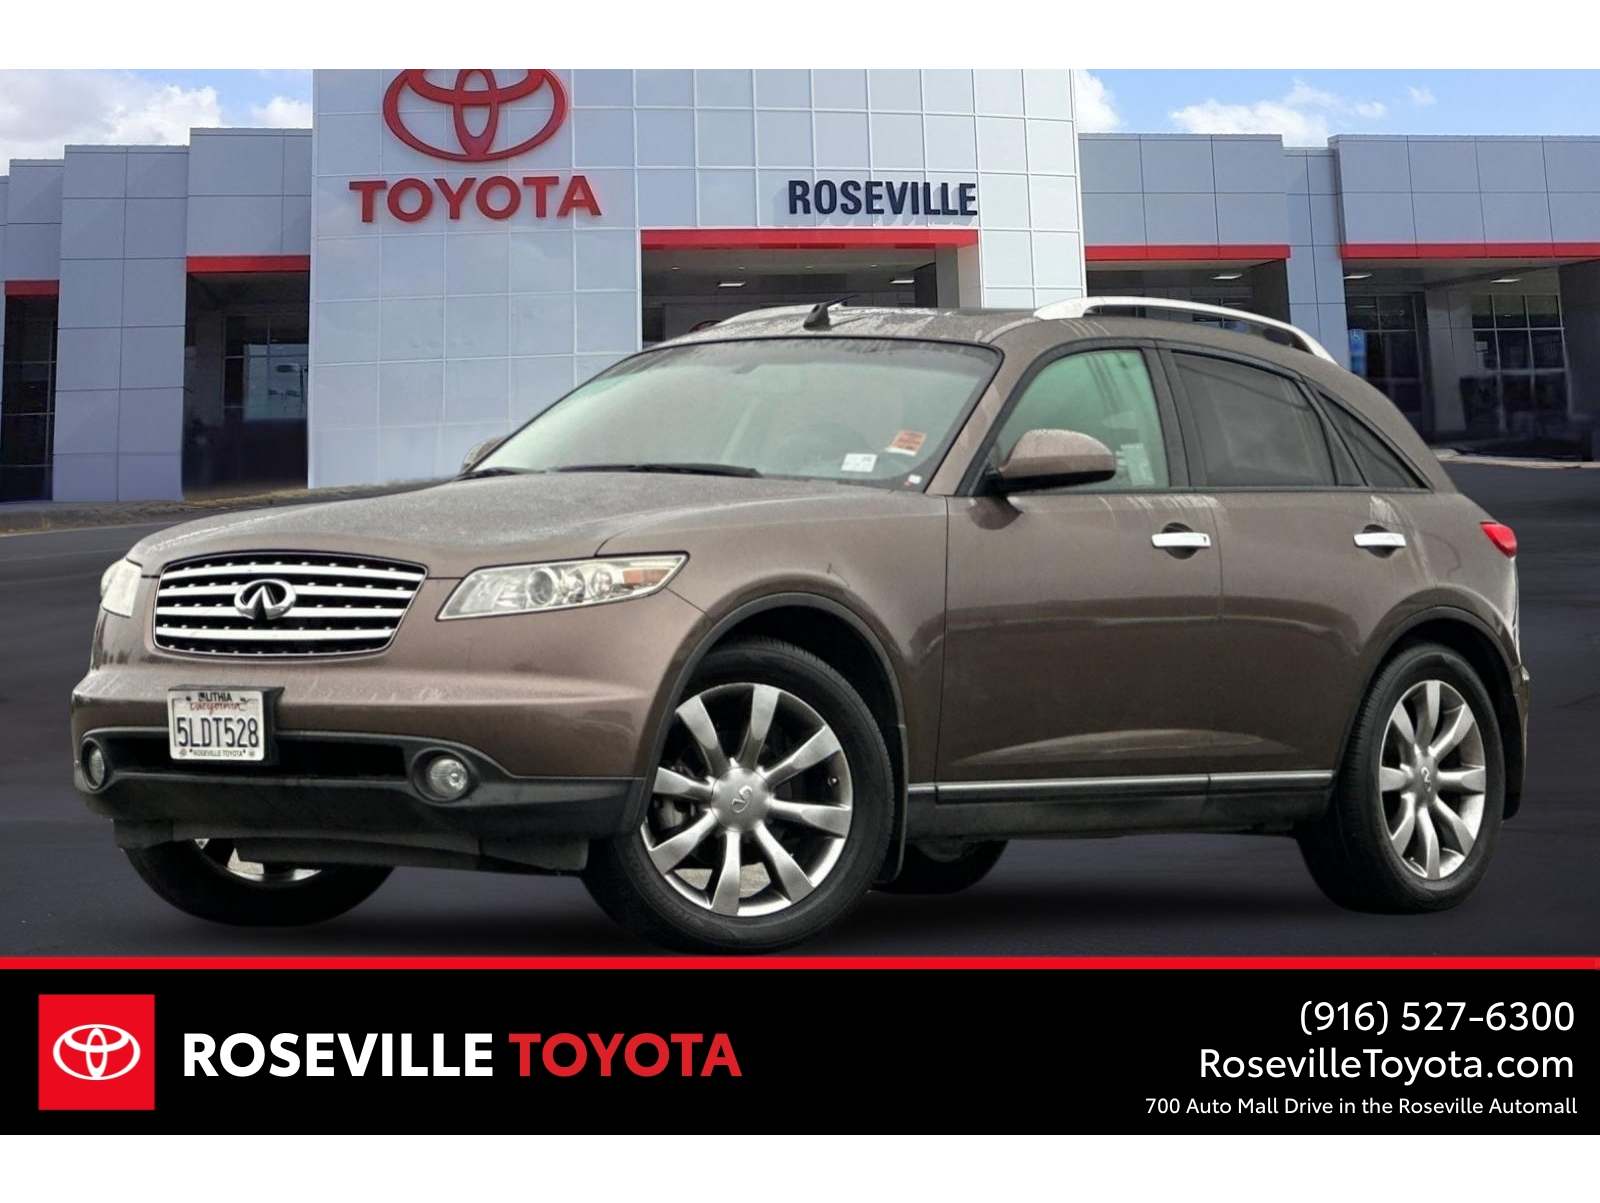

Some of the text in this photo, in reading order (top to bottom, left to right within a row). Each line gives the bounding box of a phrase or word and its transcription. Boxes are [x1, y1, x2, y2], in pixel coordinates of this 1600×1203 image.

[349, 174, 602, 224] TOYOTA
[788, 179, 978, 217] ROSEVILLE
[176, 717, 259, 748] 5LDT528
